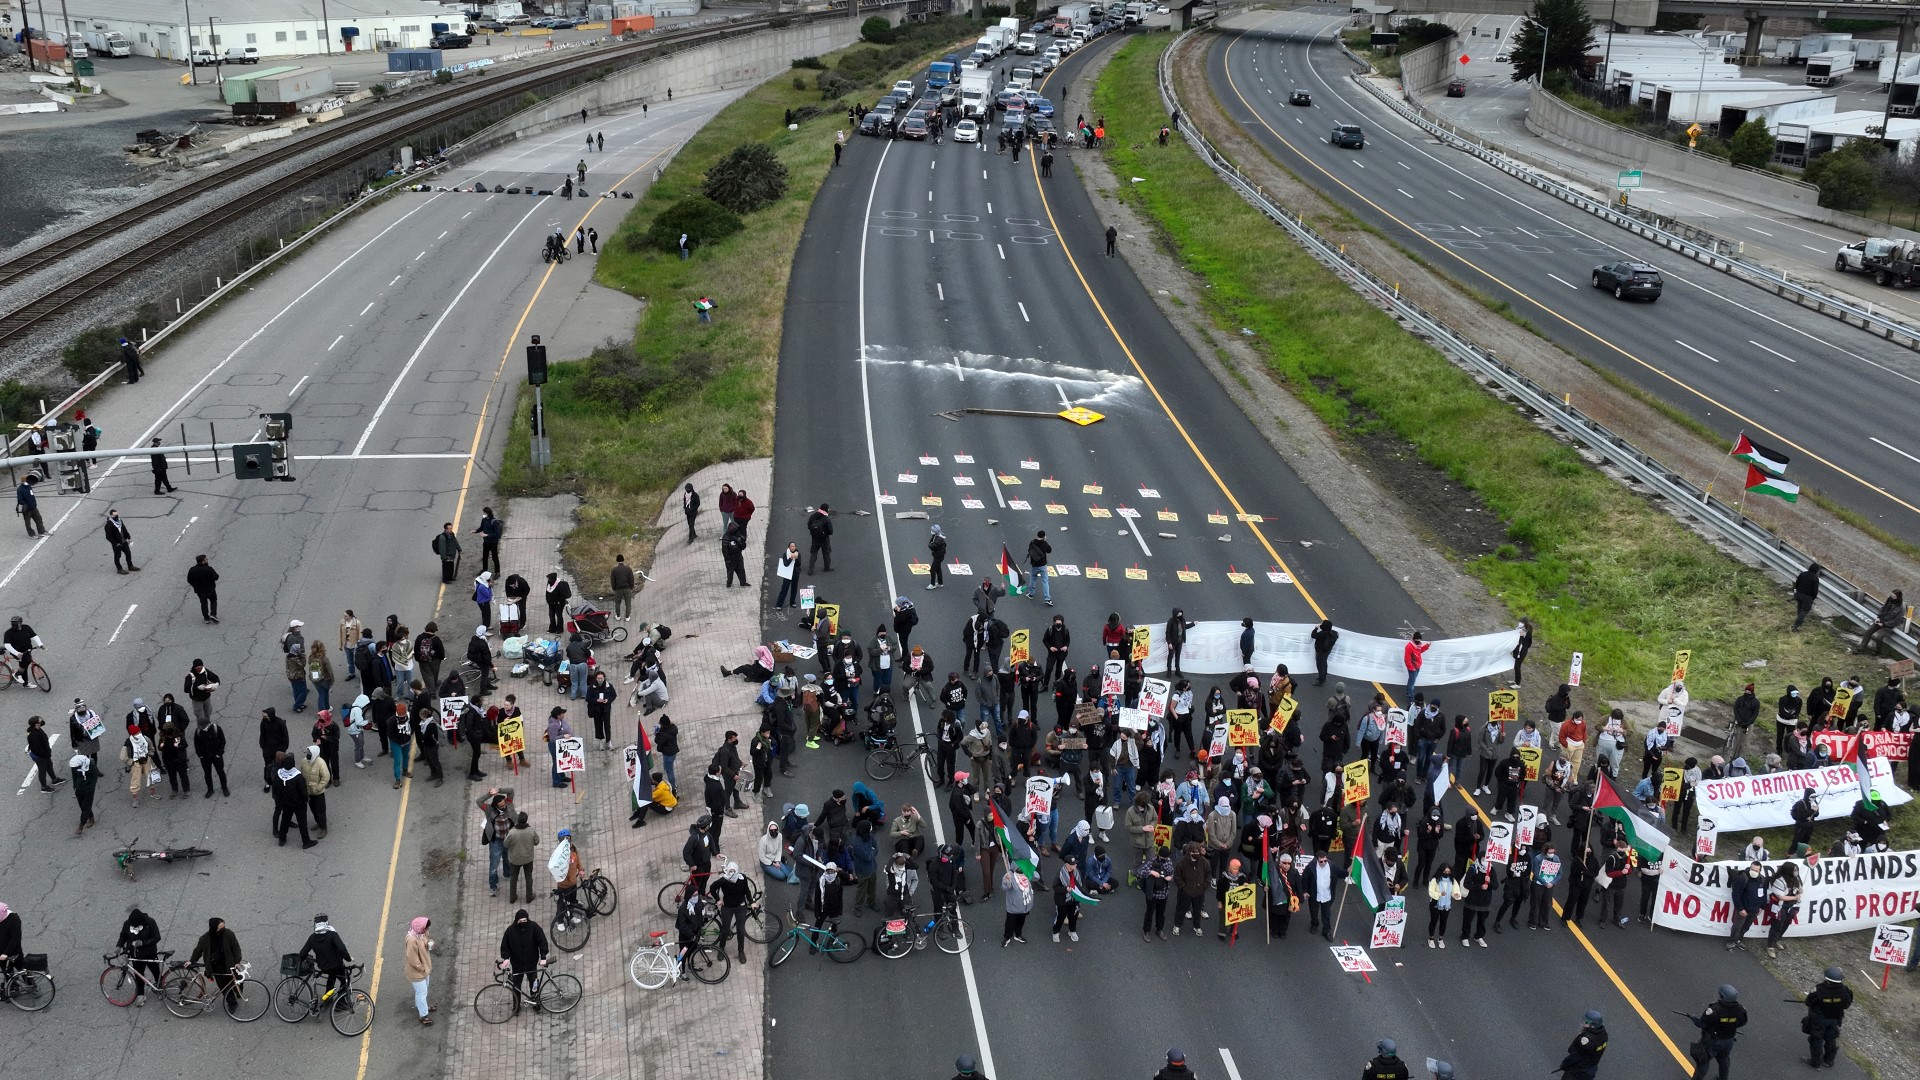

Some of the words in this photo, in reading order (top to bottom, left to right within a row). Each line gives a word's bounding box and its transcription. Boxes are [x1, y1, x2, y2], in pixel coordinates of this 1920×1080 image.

[1815, 733, 1875, 758] STOP
[1707, 780, 1745, 800] STOP
[1751, 773, 1819, 796] ARMING
[1493, 844, 1506, 853] PALE
[1810, 853, 1918, 886] DEMANDS
[1663, 891, 1701, 919] NO
[1808, 897, 1847, 923] FOR
[1890, 955, 1906, 964] STINE
[1891, 949, 1906, 958] PALE
